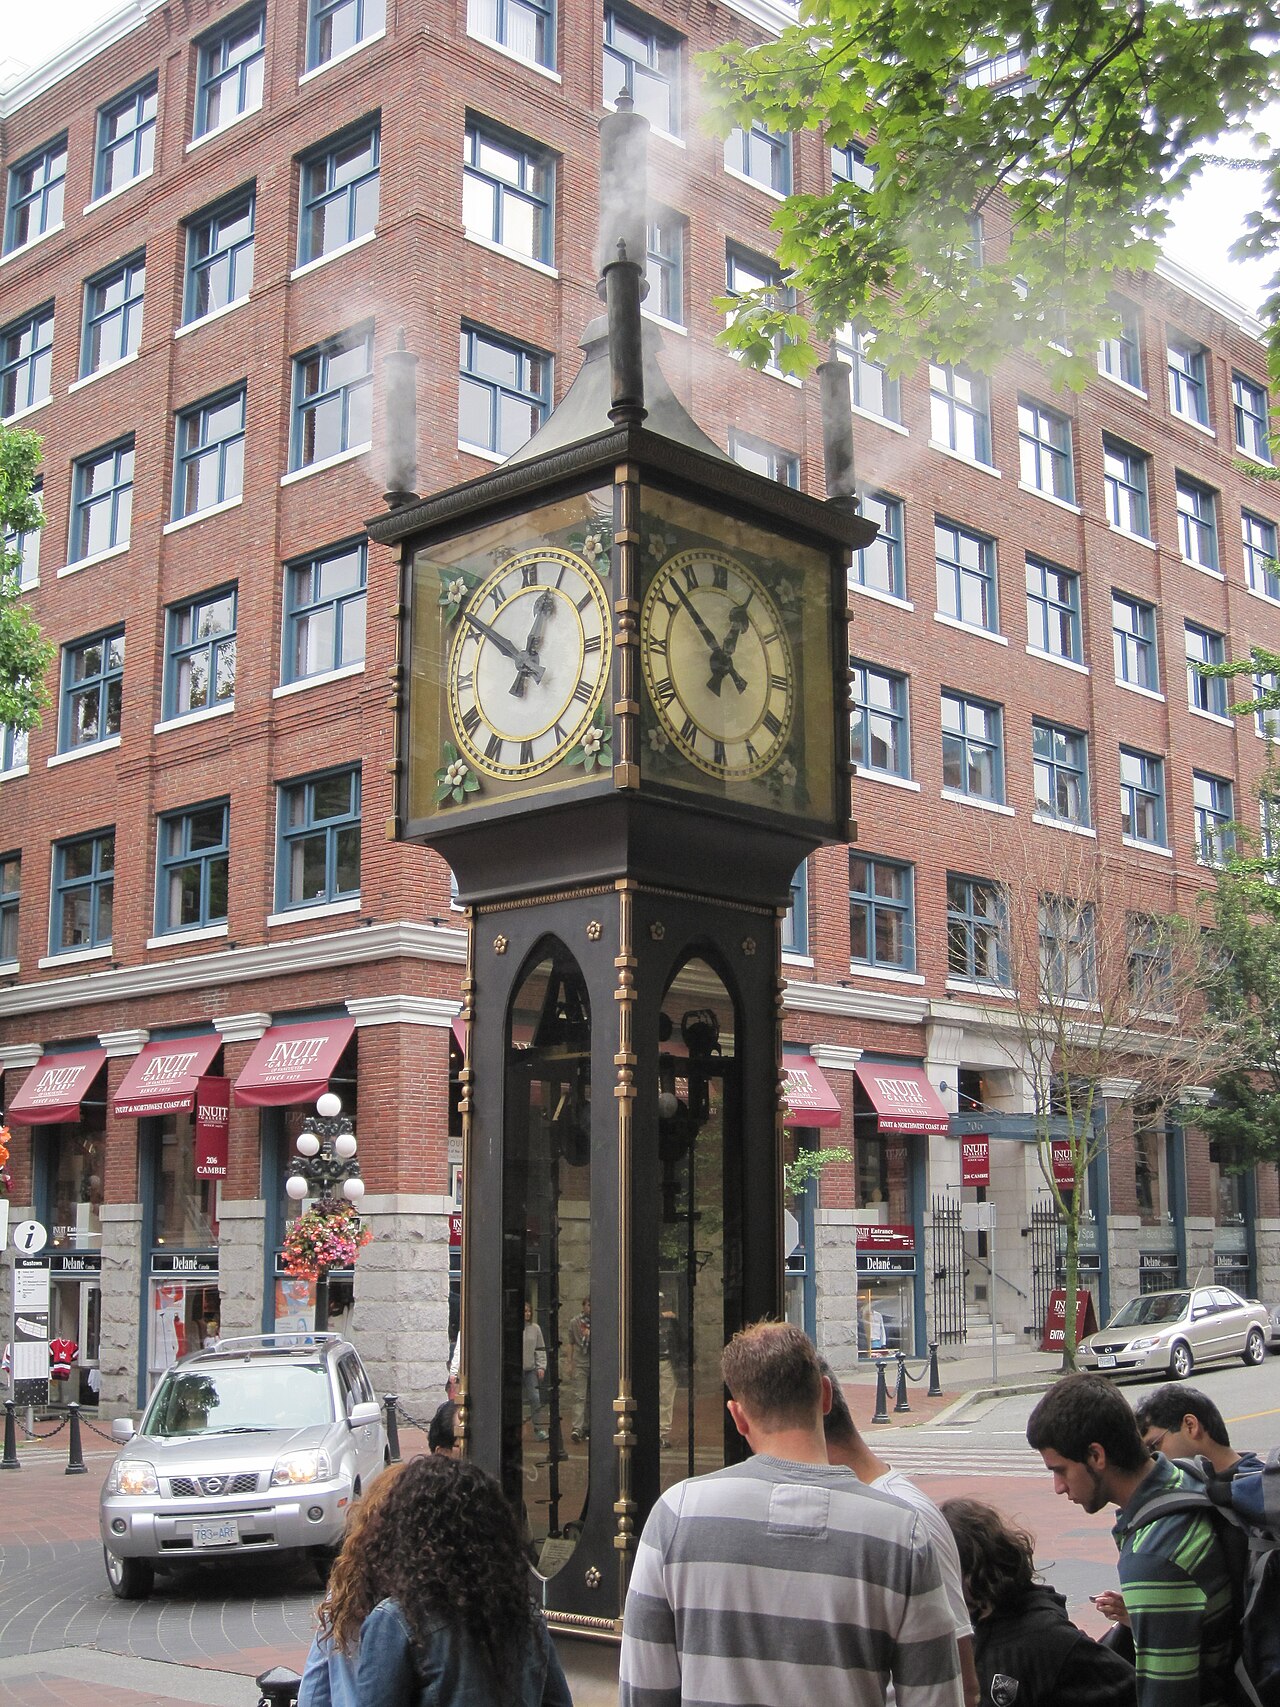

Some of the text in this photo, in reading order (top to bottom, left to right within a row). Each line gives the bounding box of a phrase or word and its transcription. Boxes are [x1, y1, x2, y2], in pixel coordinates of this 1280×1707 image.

[657, 588, 679, 617] X
[466, 626, 482, 645] X
[584, 634, 601, 654] III
[649, 633, 667, 656] IX
[458, 670, 474, 691] IX
[771, 674, 787, 692] III
[573, 678, 595, 705] IIII
[655, 676, 677, 710] VIII
[553, 722, 569, 747] V
[744, 738, 761, 764] V
[267, 1036, 330, 1062] INUIT
[143, 1051, 199, 1075] INUIT
[267, 1057, 314, 1069] GALLERY
[36, 1065, 87, 1087] INUIT
[143, 1071, 183, 1081] GALLERY
[781, 1068, 813, 1089] UIT
[36, 1083, 72, 1093] GALLERY
[874, 1077, 923, 1098] INUIT
[115, 1105, 128, 1114] INUIT
[133, 1102, 164, 1112] NORTHWEST
[163, 1101, 180, 1109] COAST
[180, 1099, 191, 1108] ART
[887, 1095, 925, 1104] GALLERY
[198, 1105, 229, 1117] INUIT
[898, 1122, 925, 1130] NORTHWEST
[967, 1121, 984, 1131] 206
[963, 1143, 989, 1154] INUIT
[206, 1156, 218, 1164] 206
[196, 1166, 227, 1175] CAMBIE
[62, 1256, 85, 1270] Delané
[172, 1255, 198, 1270] Delané
[866, 1257, 891, 1270] Delané
